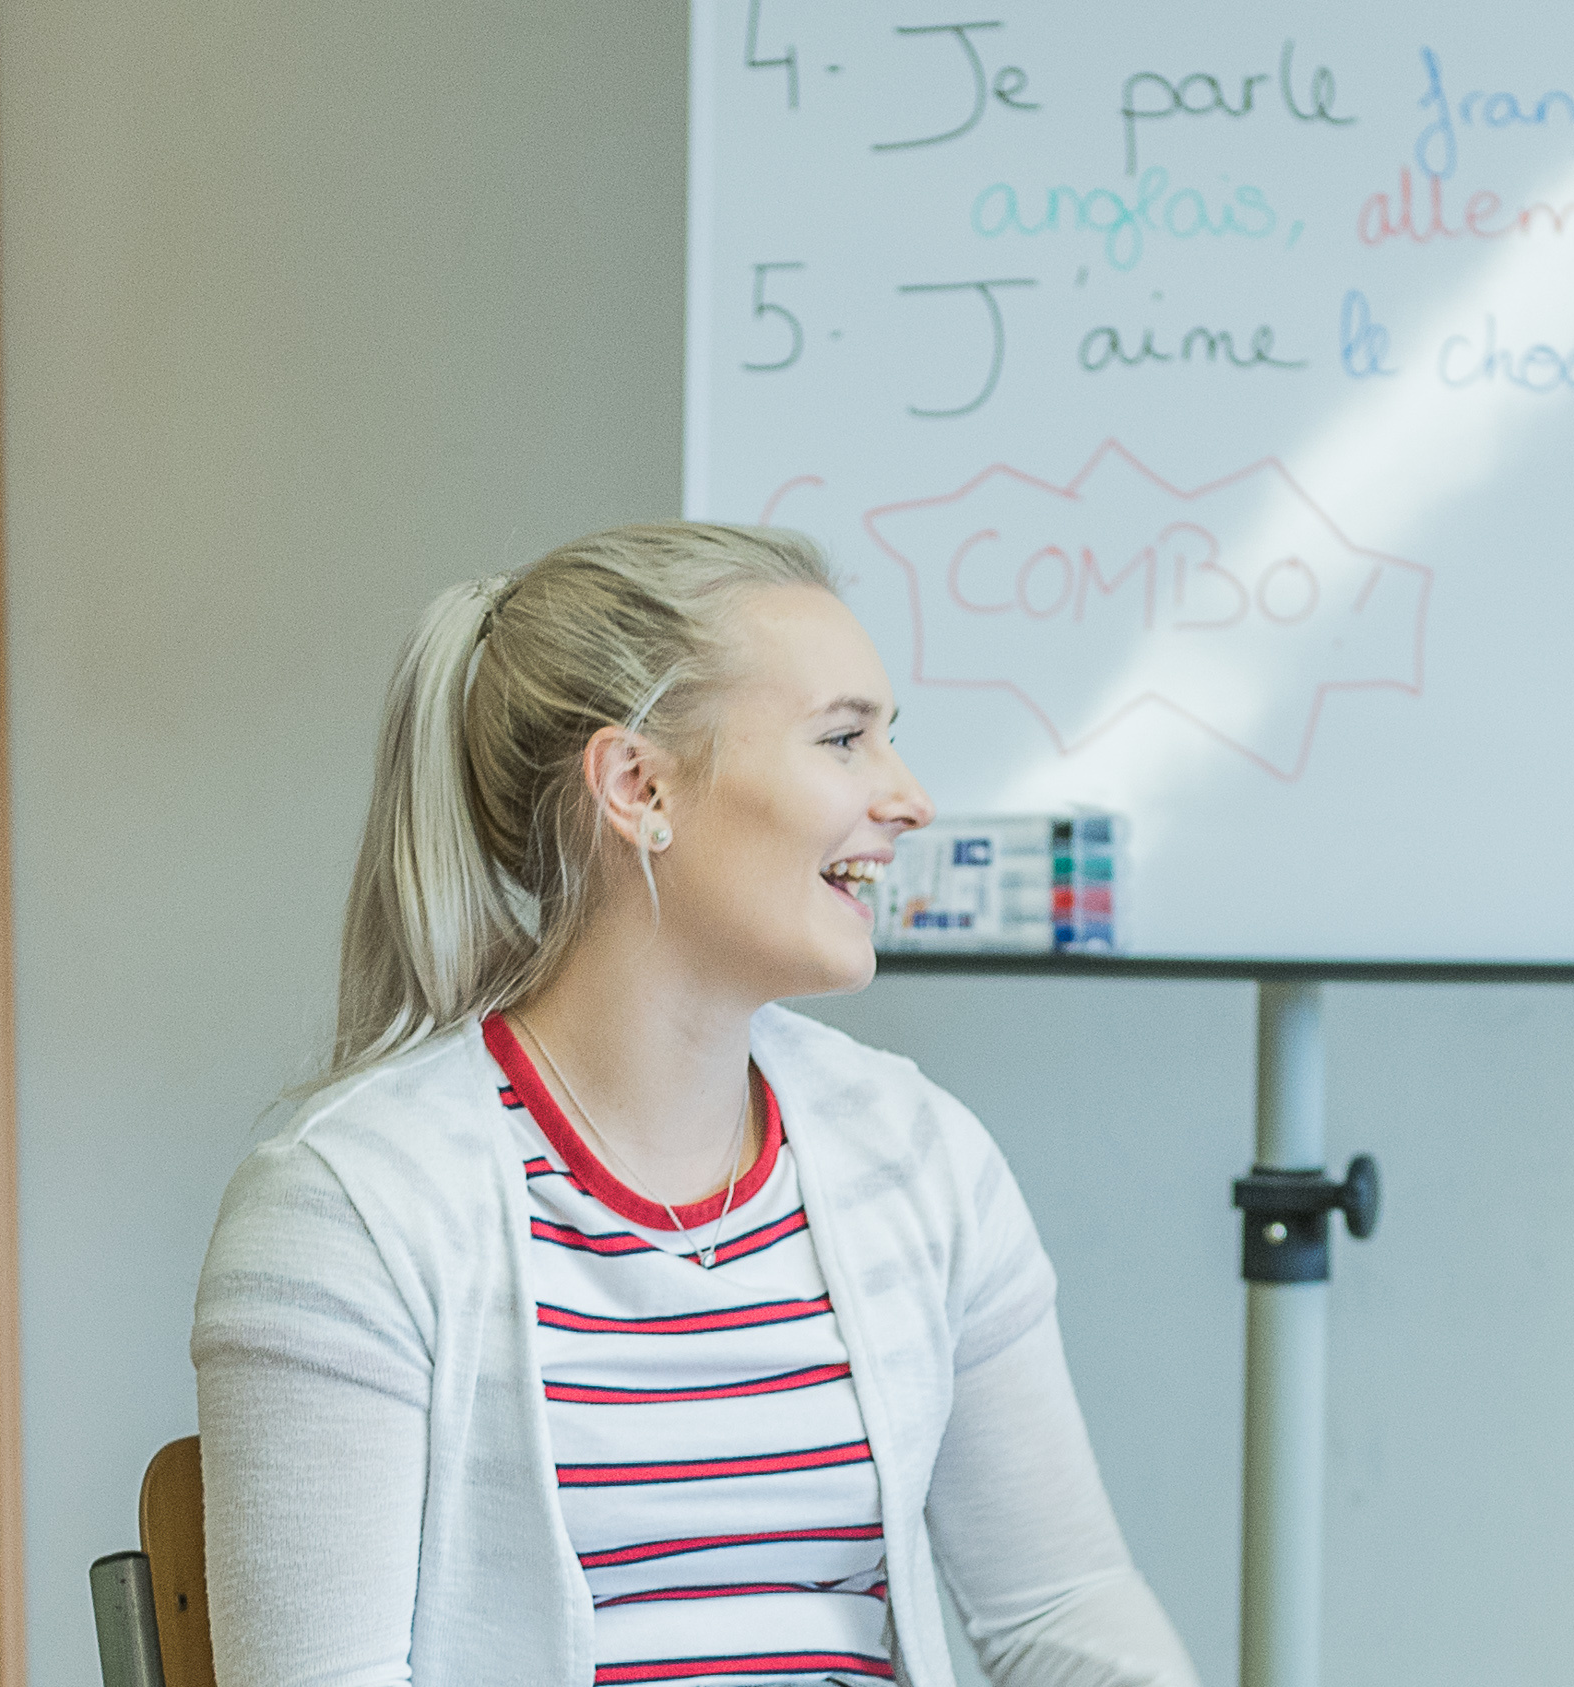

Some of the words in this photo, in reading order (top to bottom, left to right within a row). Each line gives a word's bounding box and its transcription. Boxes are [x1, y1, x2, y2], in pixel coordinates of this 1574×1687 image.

[870, 20, 1042, 153] Je
[1121, 36, 1358, 177] parle
[1339, 288, 1400, 380] le
